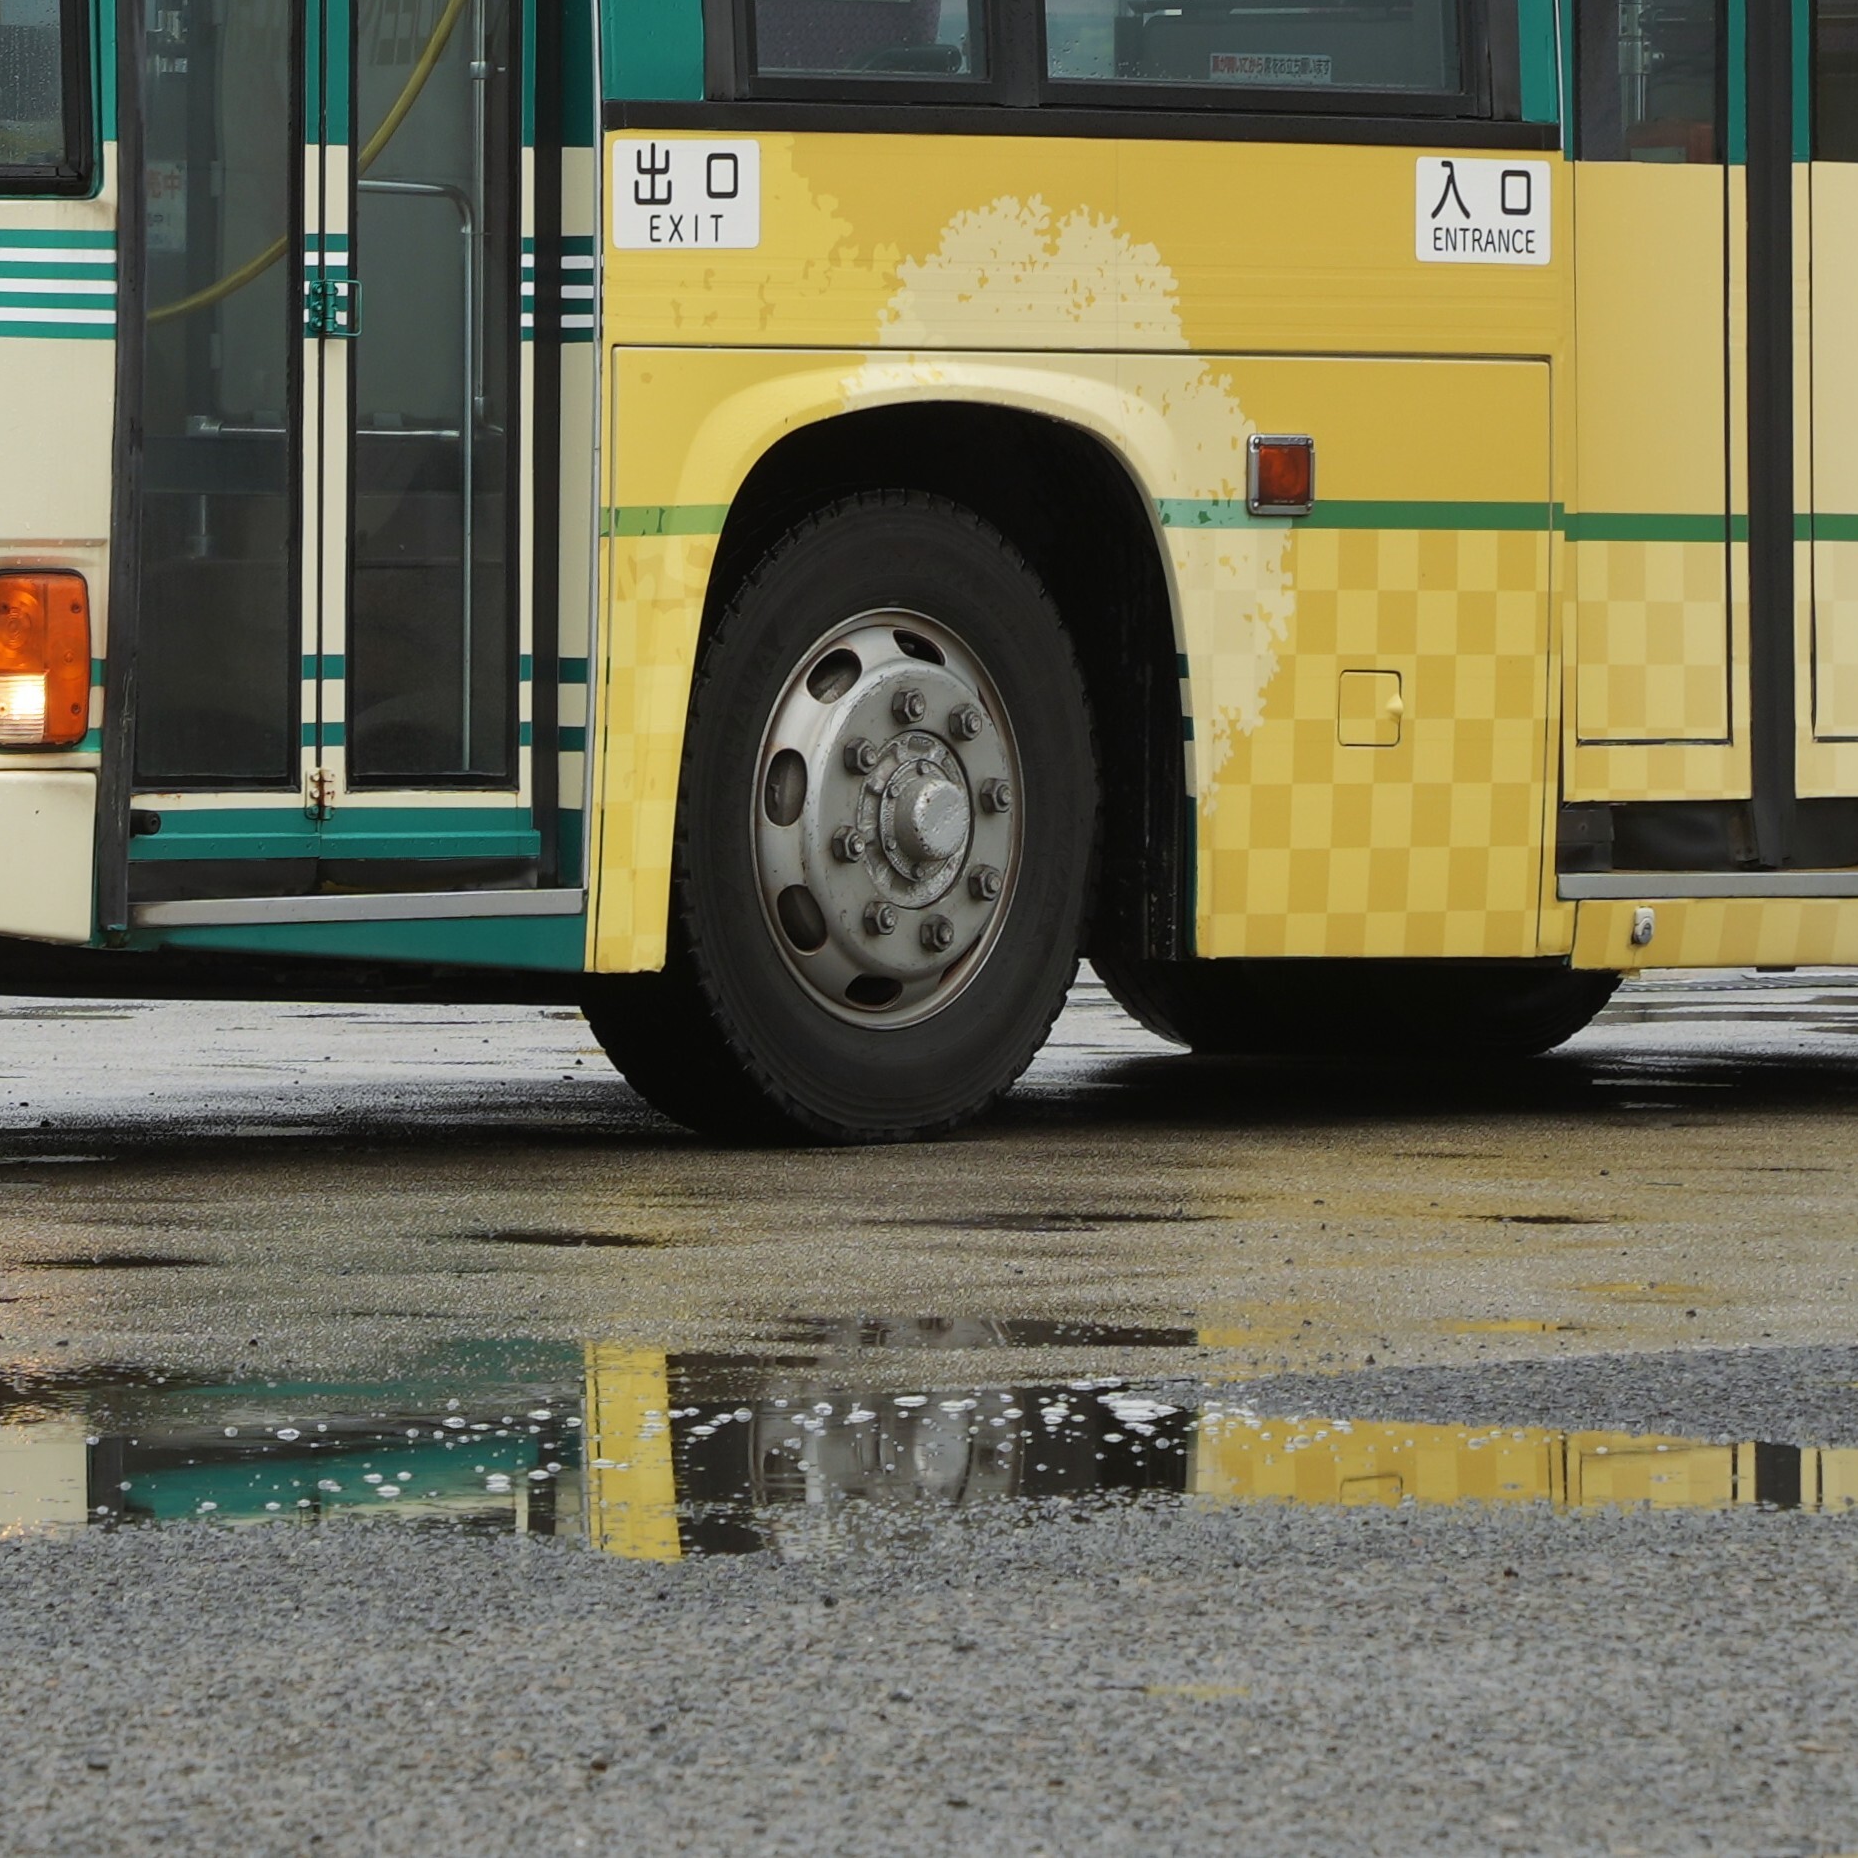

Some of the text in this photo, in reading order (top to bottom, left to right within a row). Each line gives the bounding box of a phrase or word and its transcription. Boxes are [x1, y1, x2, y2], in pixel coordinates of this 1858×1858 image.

[634, 142, 738, 205] 出口
[1431, 160, 1531, 219] 入口
[649, 214, 724, 243] EXIT
[1433, 227, 1536, 254] ENTRANCE
